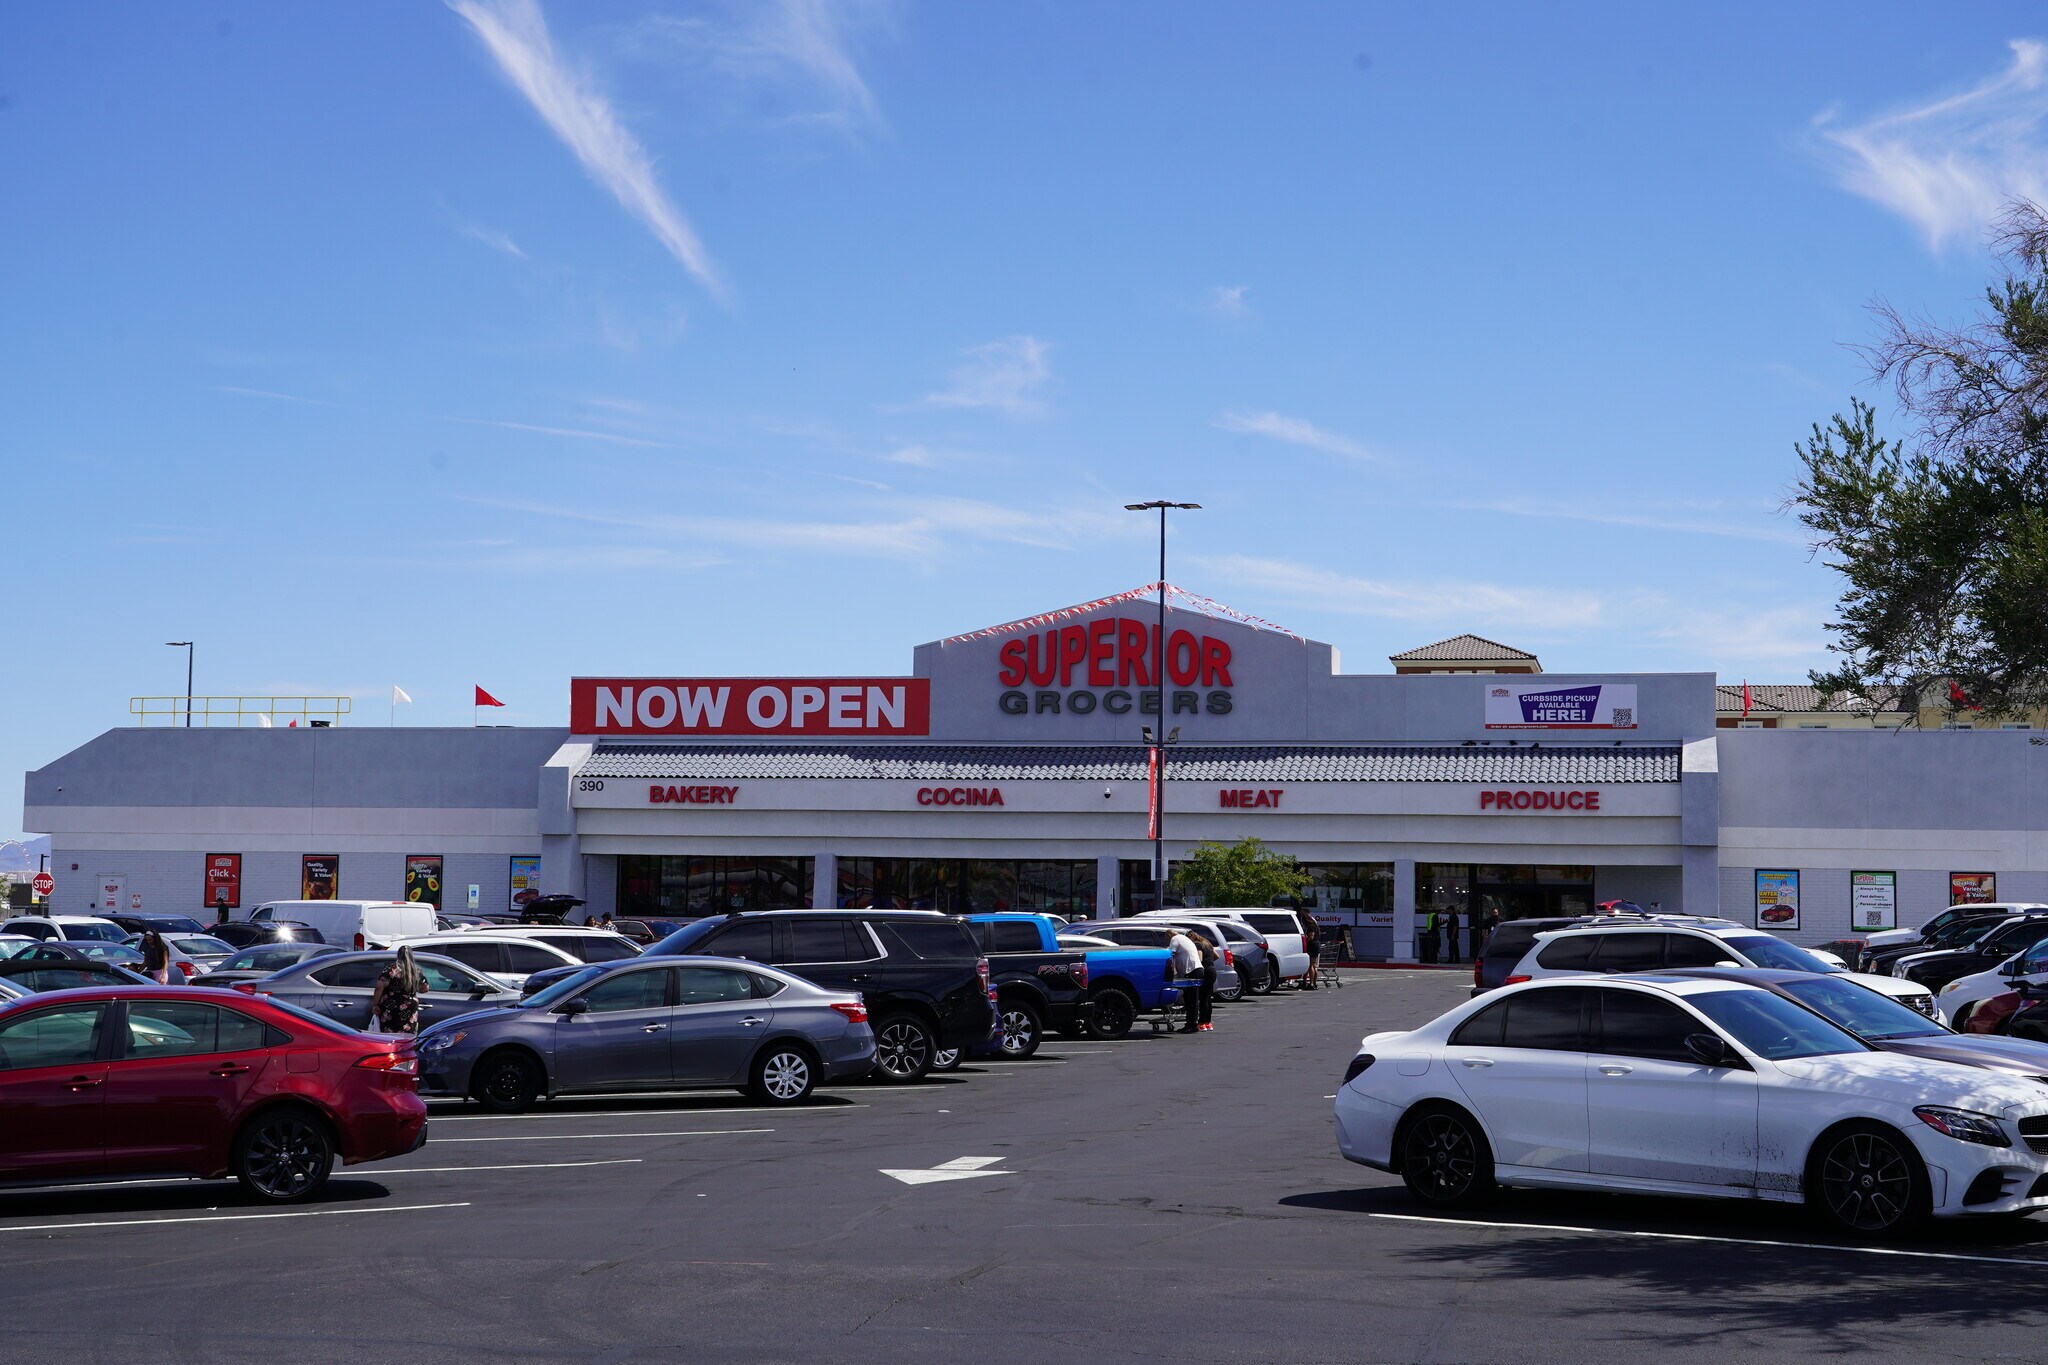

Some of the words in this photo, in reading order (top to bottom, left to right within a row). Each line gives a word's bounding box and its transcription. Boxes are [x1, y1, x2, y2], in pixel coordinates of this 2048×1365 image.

[999, 617, 1234, 688] SUPERIOR
[595, 685, 731, 729] NOW
[746, 685, 906, 729] OPEN
[999, 690, 1234, 714] GROCERS
[1532, 709, 1587, 721] HERE!
[579, 780, 604, 792] 390
[649, 785, 739, 804] BAKERY
[917, 787, 1004, 806] COCINA
[1220, 789, 1284, 808] MEAT
[1480, 790, 1600, 810] PRODUCE
[208, 868, 230, 877] Click
[34, 879, 53, 889] STOP
[1315, 915, 1341, 923] Quality
